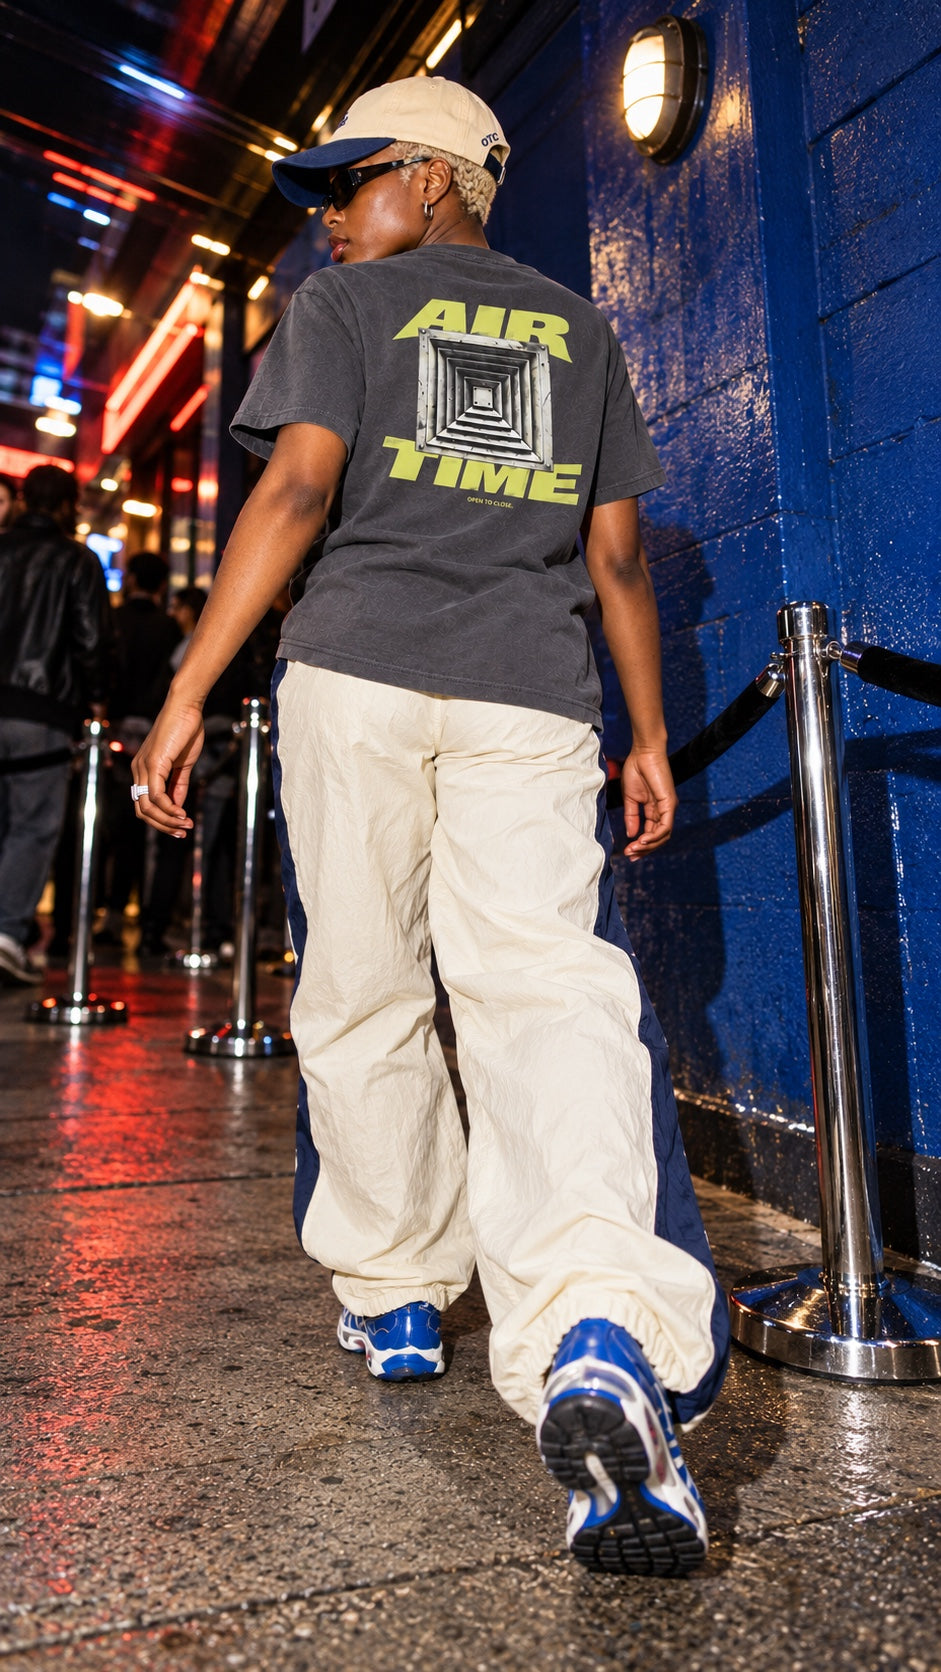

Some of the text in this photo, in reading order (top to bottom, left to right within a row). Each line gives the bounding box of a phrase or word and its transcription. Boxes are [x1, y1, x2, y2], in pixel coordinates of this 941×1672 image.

[481, 132, 499, 147] OTC
[392, 298, 573, 364] AIR
[382, 435, 583, 506] TIME
[466, 496, 484, 504] OPEN
